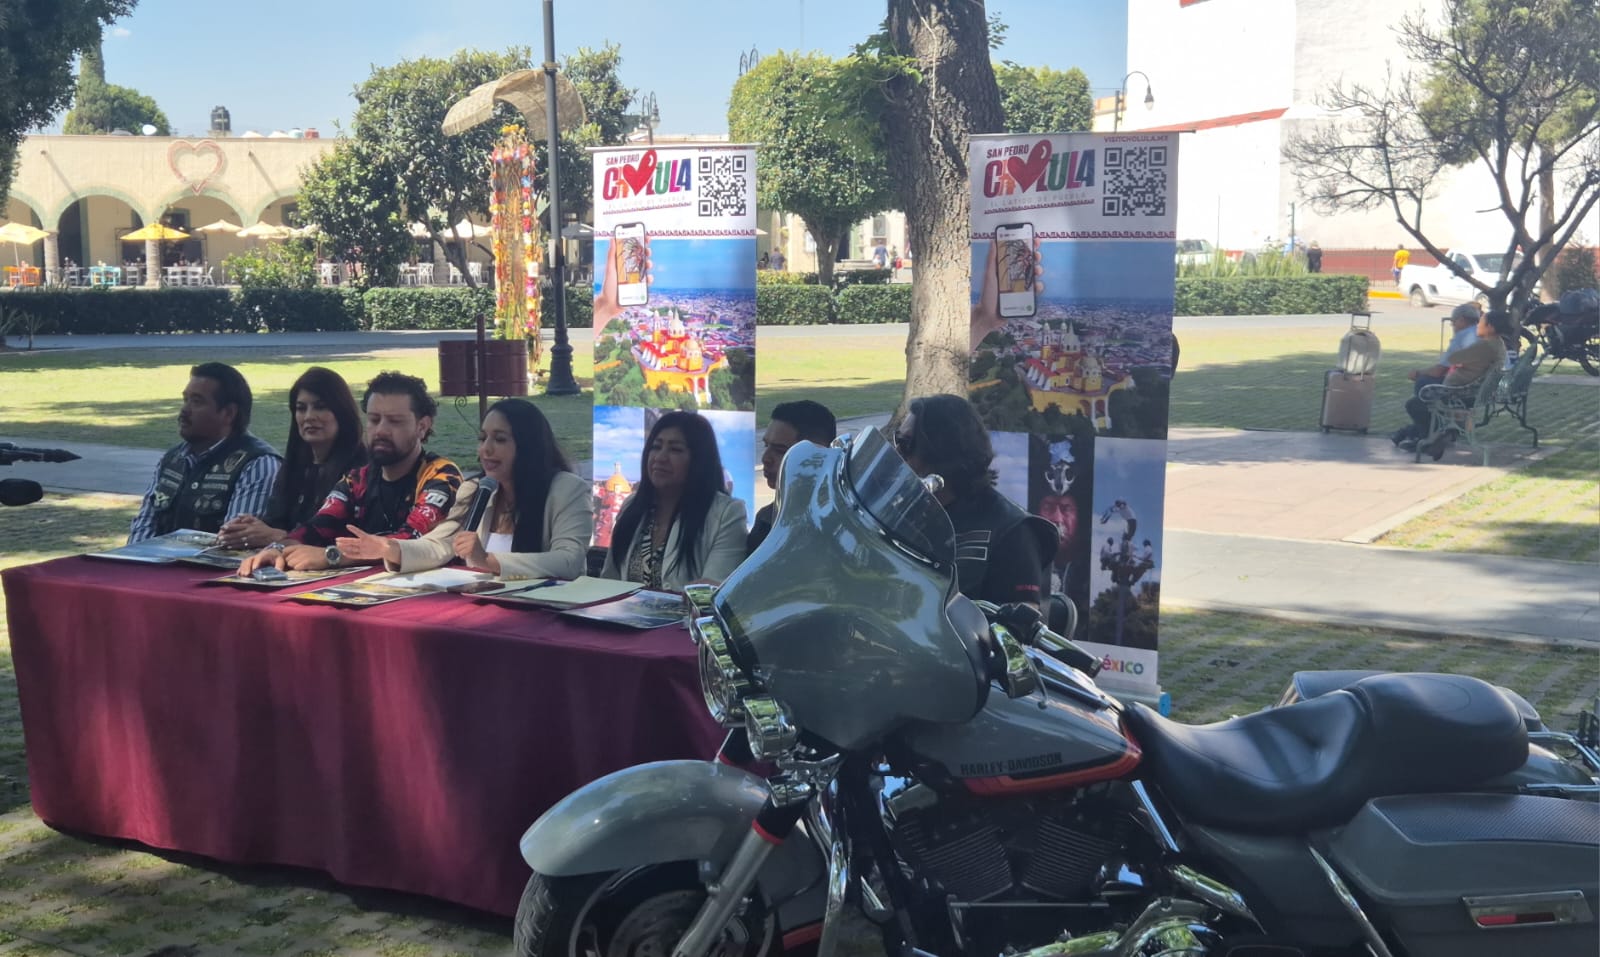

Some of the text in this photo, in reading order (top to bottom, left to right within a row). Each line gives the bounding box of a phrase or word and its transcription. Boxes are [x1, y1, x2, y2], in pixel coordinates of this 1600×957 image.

[606, 153, 640, 165] SAN PEDRO
[986, 144, 1030, 159] SAN PEDRO
[1102, 653, 1144, 675] éxico
[960, 752, 1062, 775] HARLEY-DAVIDSON
